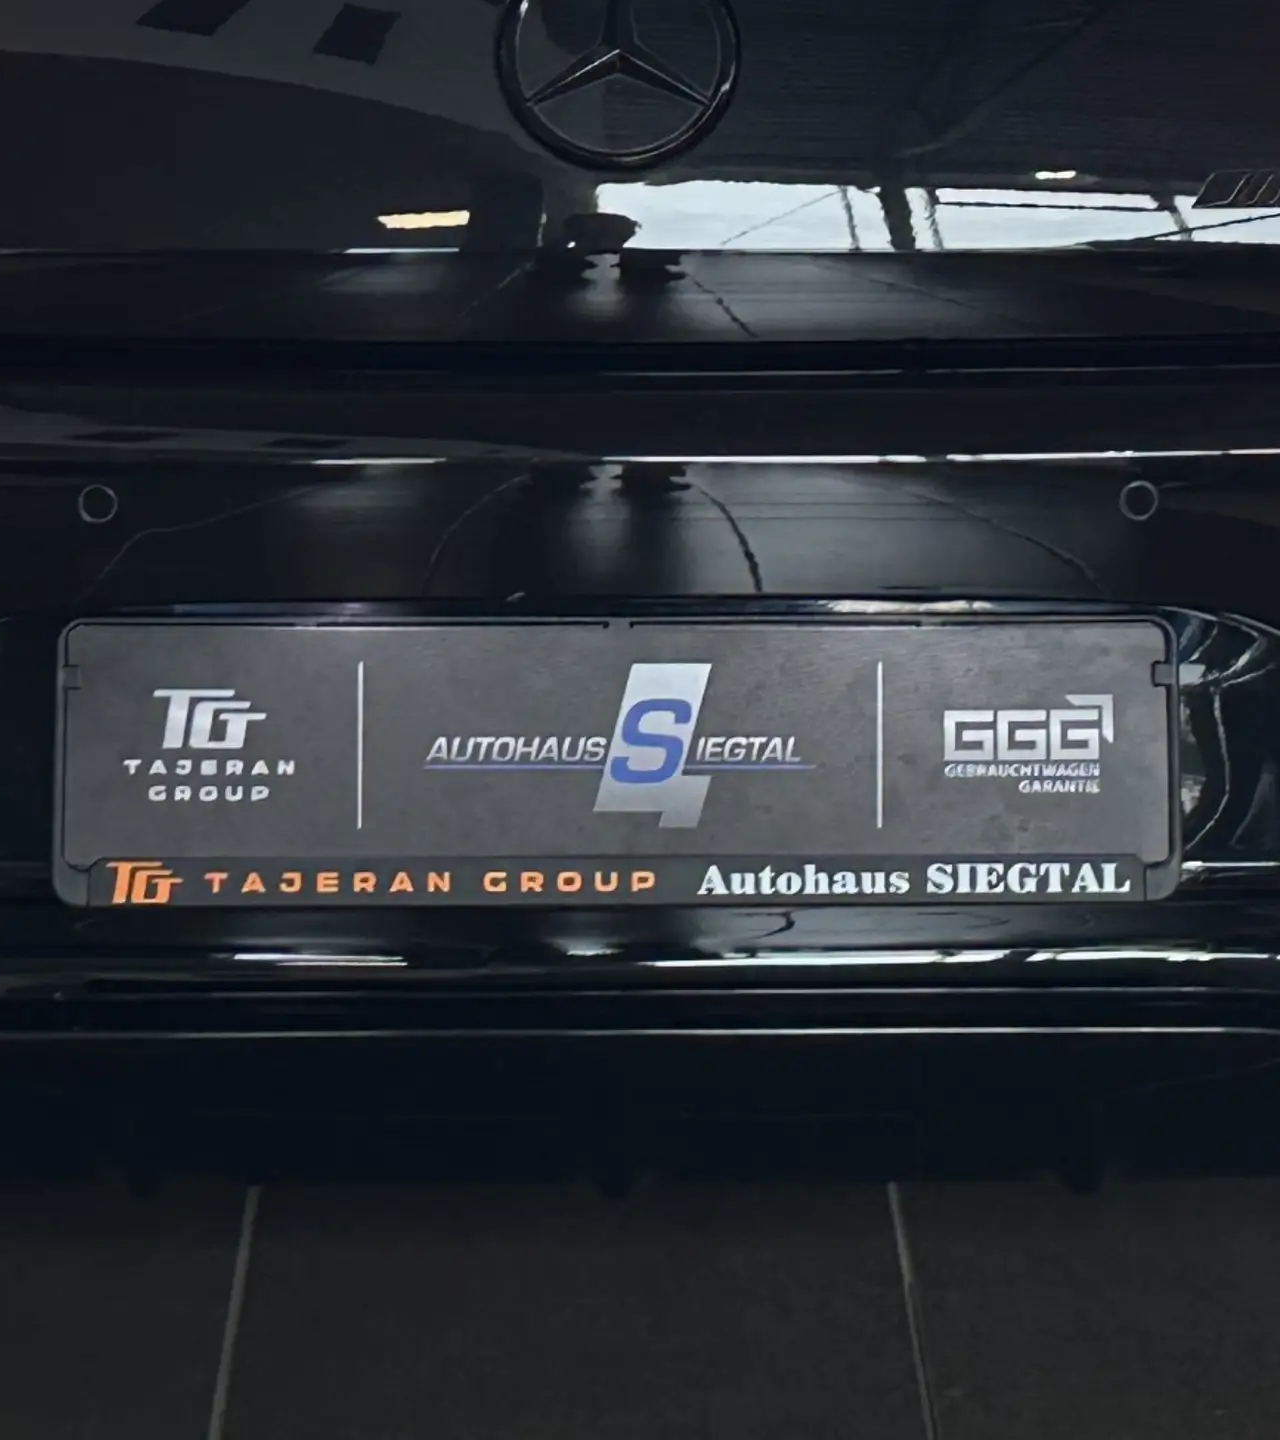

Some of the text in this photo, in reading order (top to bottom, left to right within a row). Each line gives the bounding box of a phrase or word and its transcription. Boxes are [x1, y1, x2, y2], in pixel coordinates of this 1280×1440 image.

[153, 689, 267, 749] TG
[944, 709, 1100, 761] GGG
[426, 735, 608, 762] AUTOHAUS
[123, 759, 296, 776] TAJERAN
[944, 763, 1101, 778] GEBRAUCHTWAGEN
[148, 785, 271, 802] GROUP
[1018, 778, 1101, 794] GARANTIE
[106, 861, 1132, 905] TG TAJERAN GROUP Autohaus SIEGTAL
